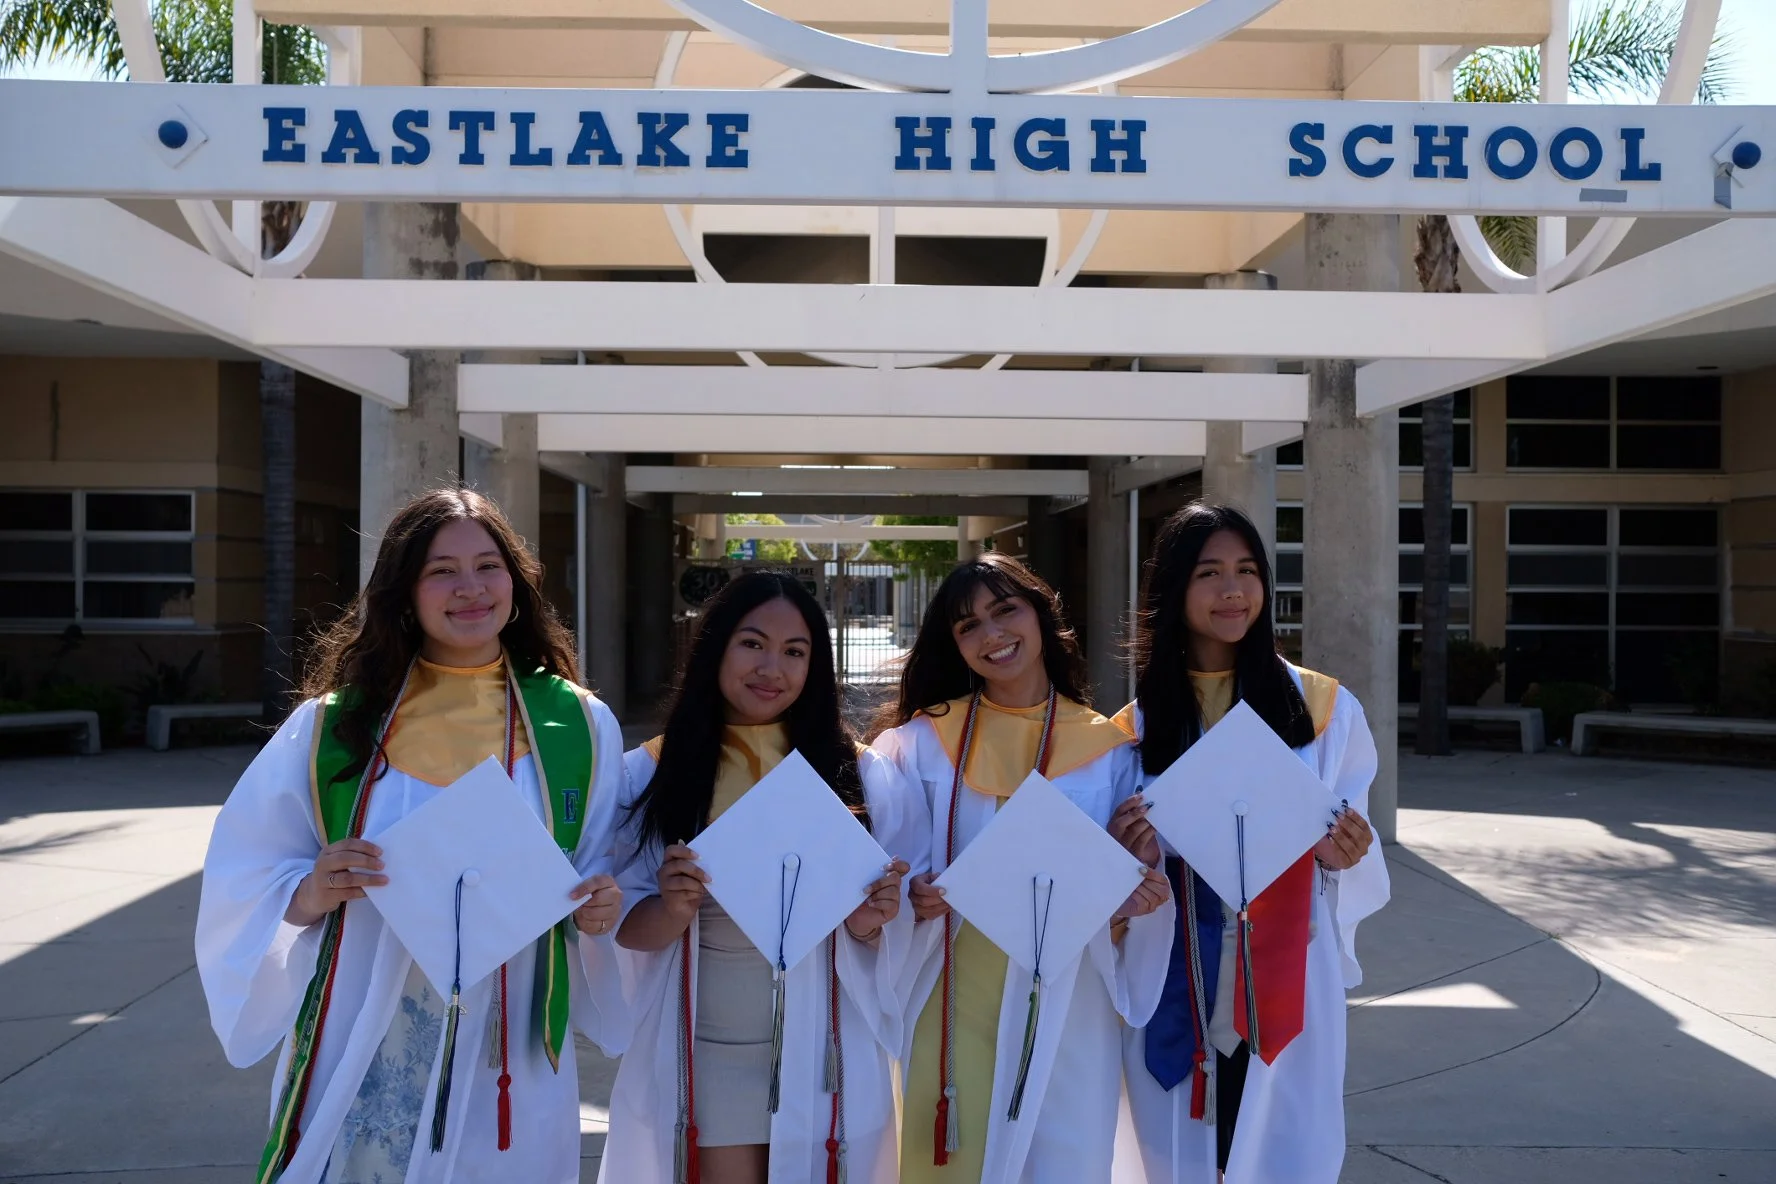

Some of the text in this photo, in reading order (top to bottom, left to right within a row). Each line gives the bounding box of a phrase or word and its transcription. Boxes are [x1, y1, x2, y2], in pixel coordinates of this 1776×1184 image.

[263, 107, 1662, 181] EASTLAKE HIGH SCHOOL
[690, 571, 721, 590] 30
